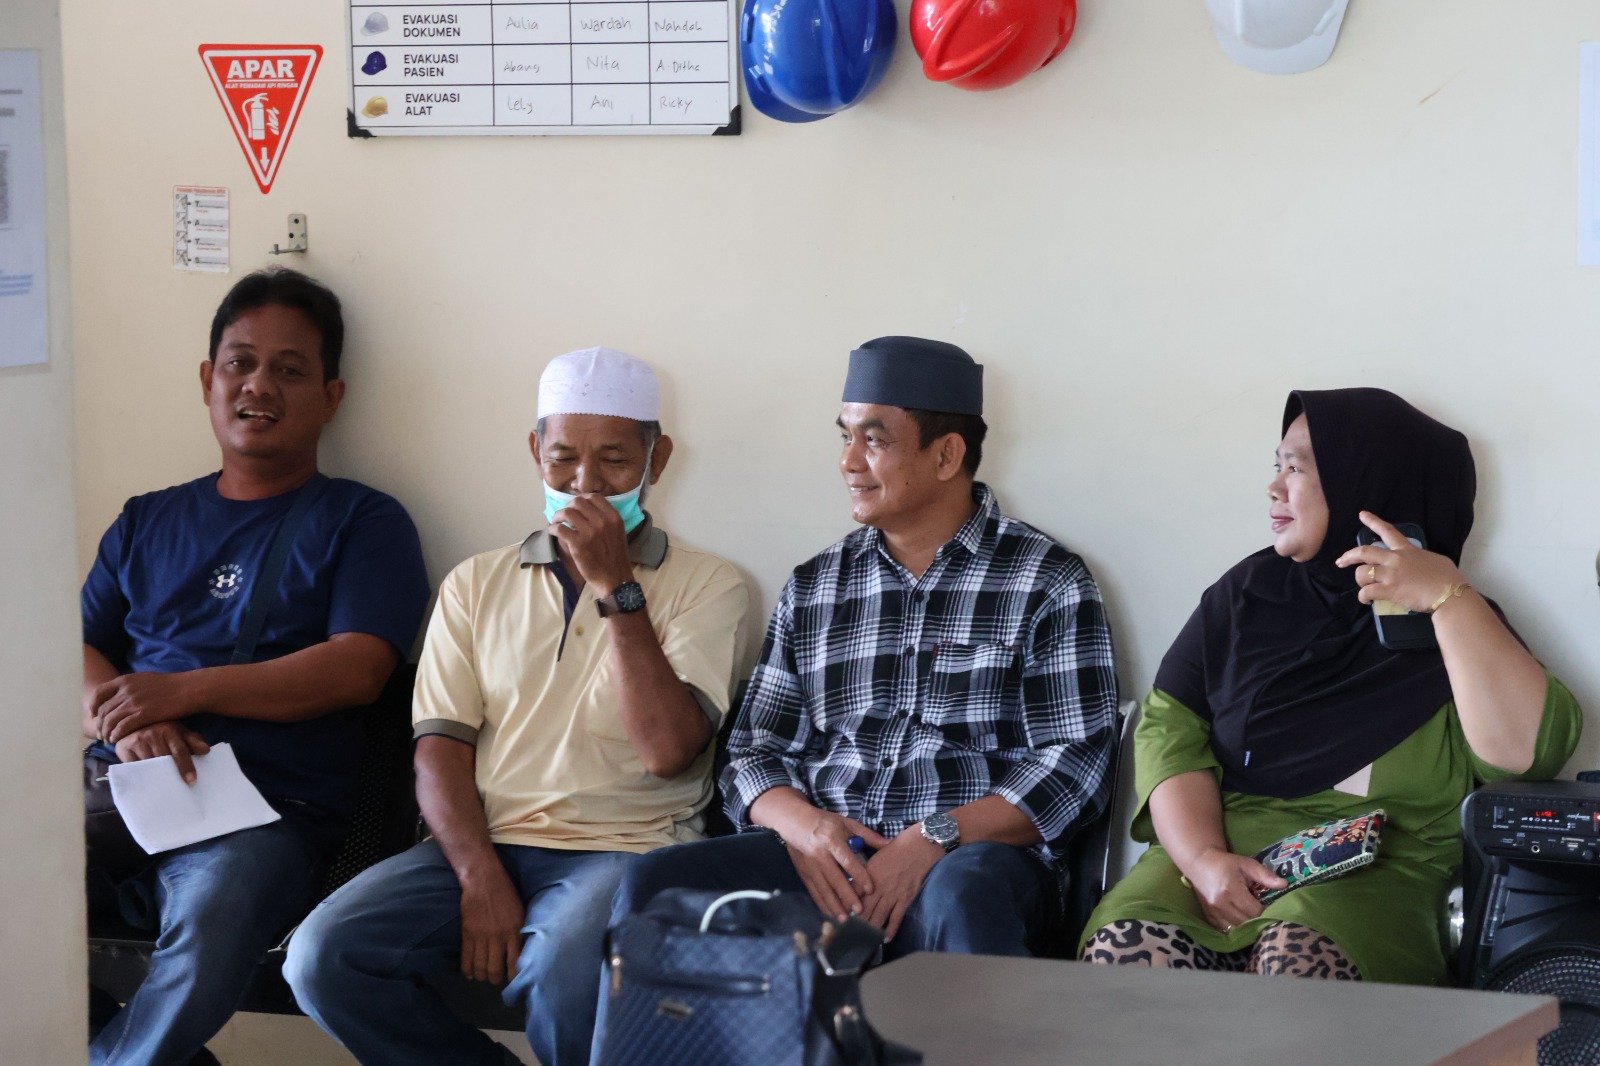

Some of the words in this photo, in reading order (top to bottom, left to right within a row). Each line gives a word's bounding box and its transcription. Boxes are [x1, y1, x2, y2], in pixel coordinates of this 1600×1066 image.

[403, 14, 458, 24] EVAKUASI
[505, 16, 539, 31] Aulia
[403, 27, 461, 37] DOKUMEN
[404, 54, 459, 64] EVAKUASI
[586, 56, 620, 71] Nita
[227, 59, 294, 79] APAR
[404, 67, 444, 77] PASIEN
[405, 93, 460, 103] EVAKUASI
[590, 95, 614, 110] Ani
[660, 96, 695, 114] Ricky
[405, 106, 433, 116] ALAT
